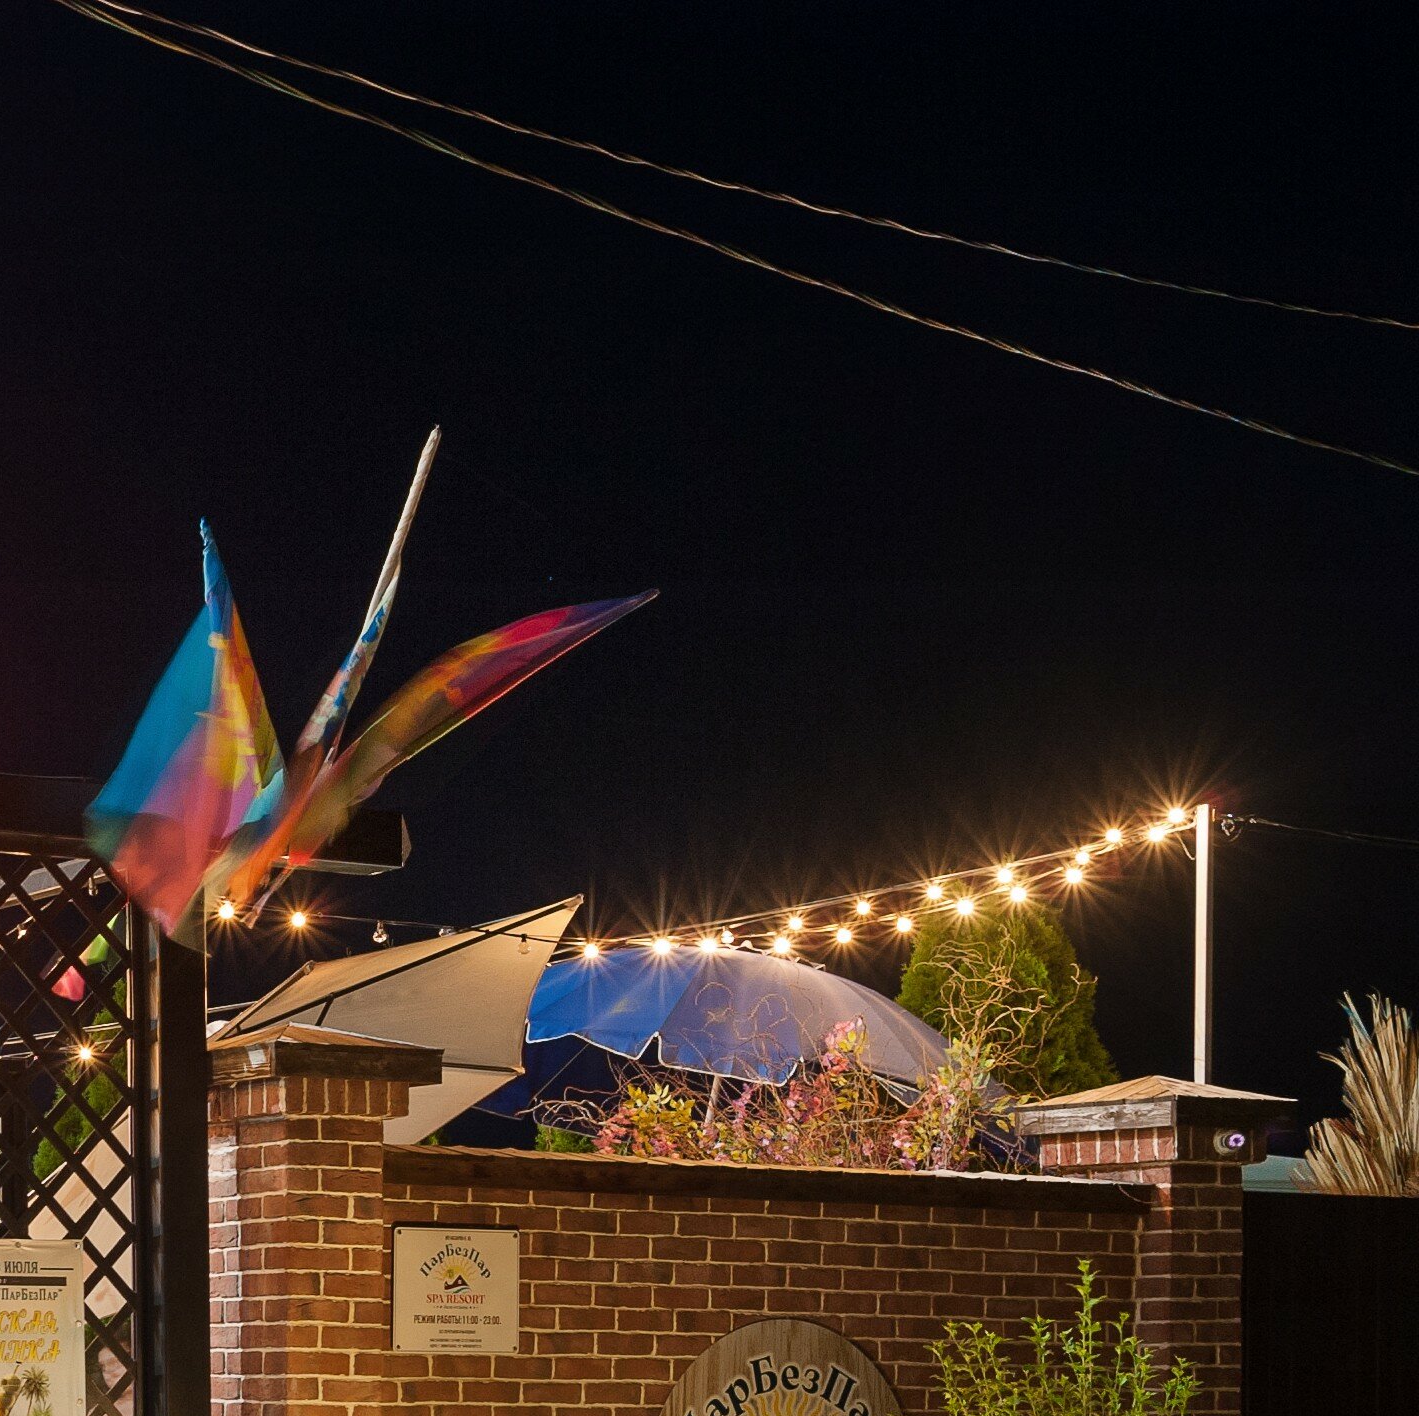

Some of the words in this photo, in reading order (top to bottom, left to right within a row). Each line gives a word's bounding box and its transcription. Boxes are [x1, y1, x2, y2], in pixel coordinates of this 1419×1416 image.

[4, 1261, 38, 1274] ИЮЛЯ
[419, 1243, 491, 1279] ПарБезПар
[426, 1294, 444, 1303] SPA
[446, 1294, 485, 1304] RESORT
